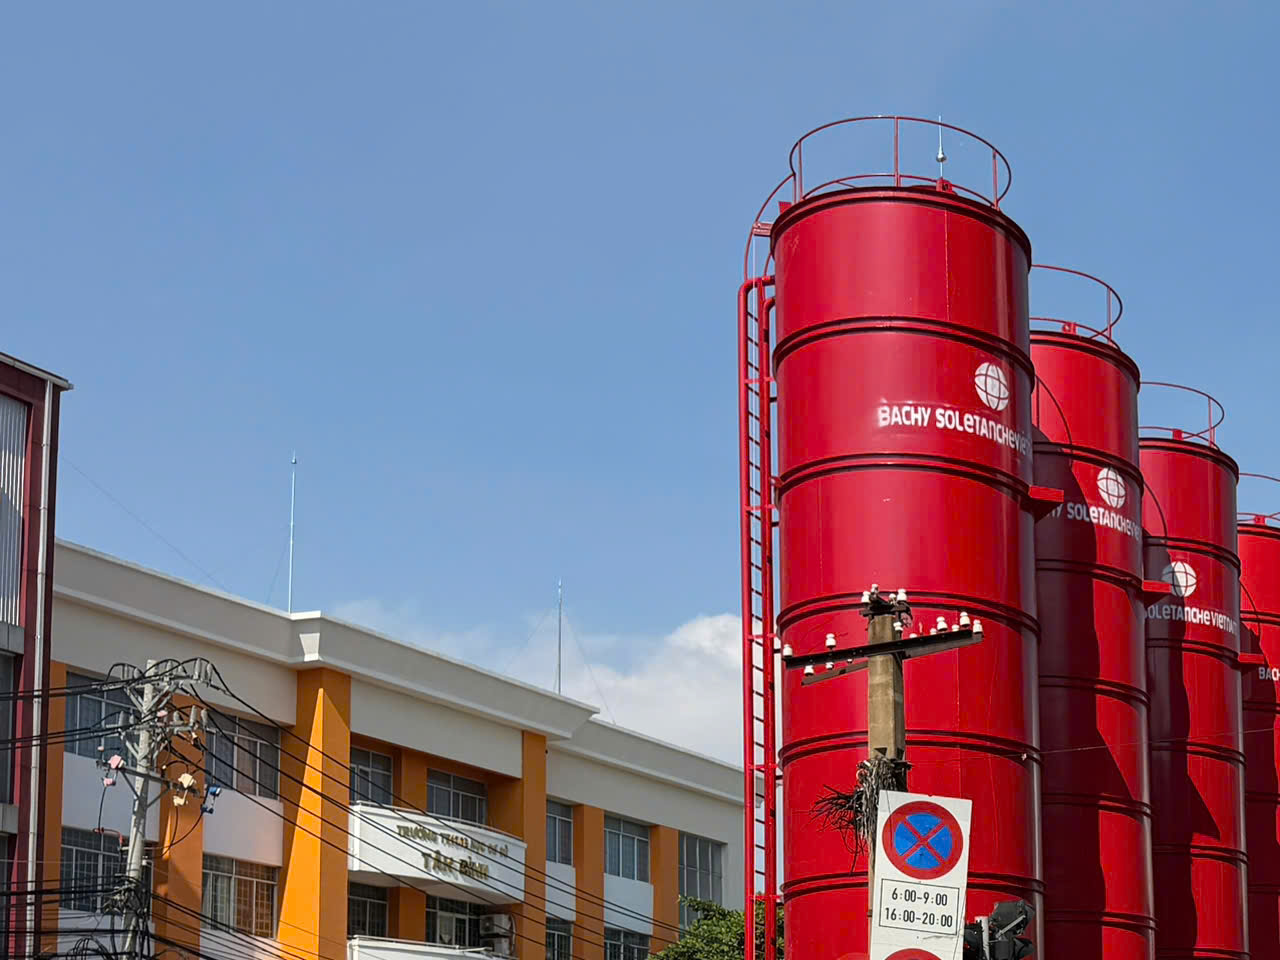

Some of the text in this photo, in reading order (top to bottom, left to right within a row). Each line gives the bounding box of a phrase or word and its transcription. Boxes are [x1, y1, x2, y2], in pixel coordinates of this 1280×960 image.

[877, 405, 931, 427] BACHY
[892, 888, 948, 906] 6:00-9:00
[885, 907, 953, 927] 16:00-20:00
